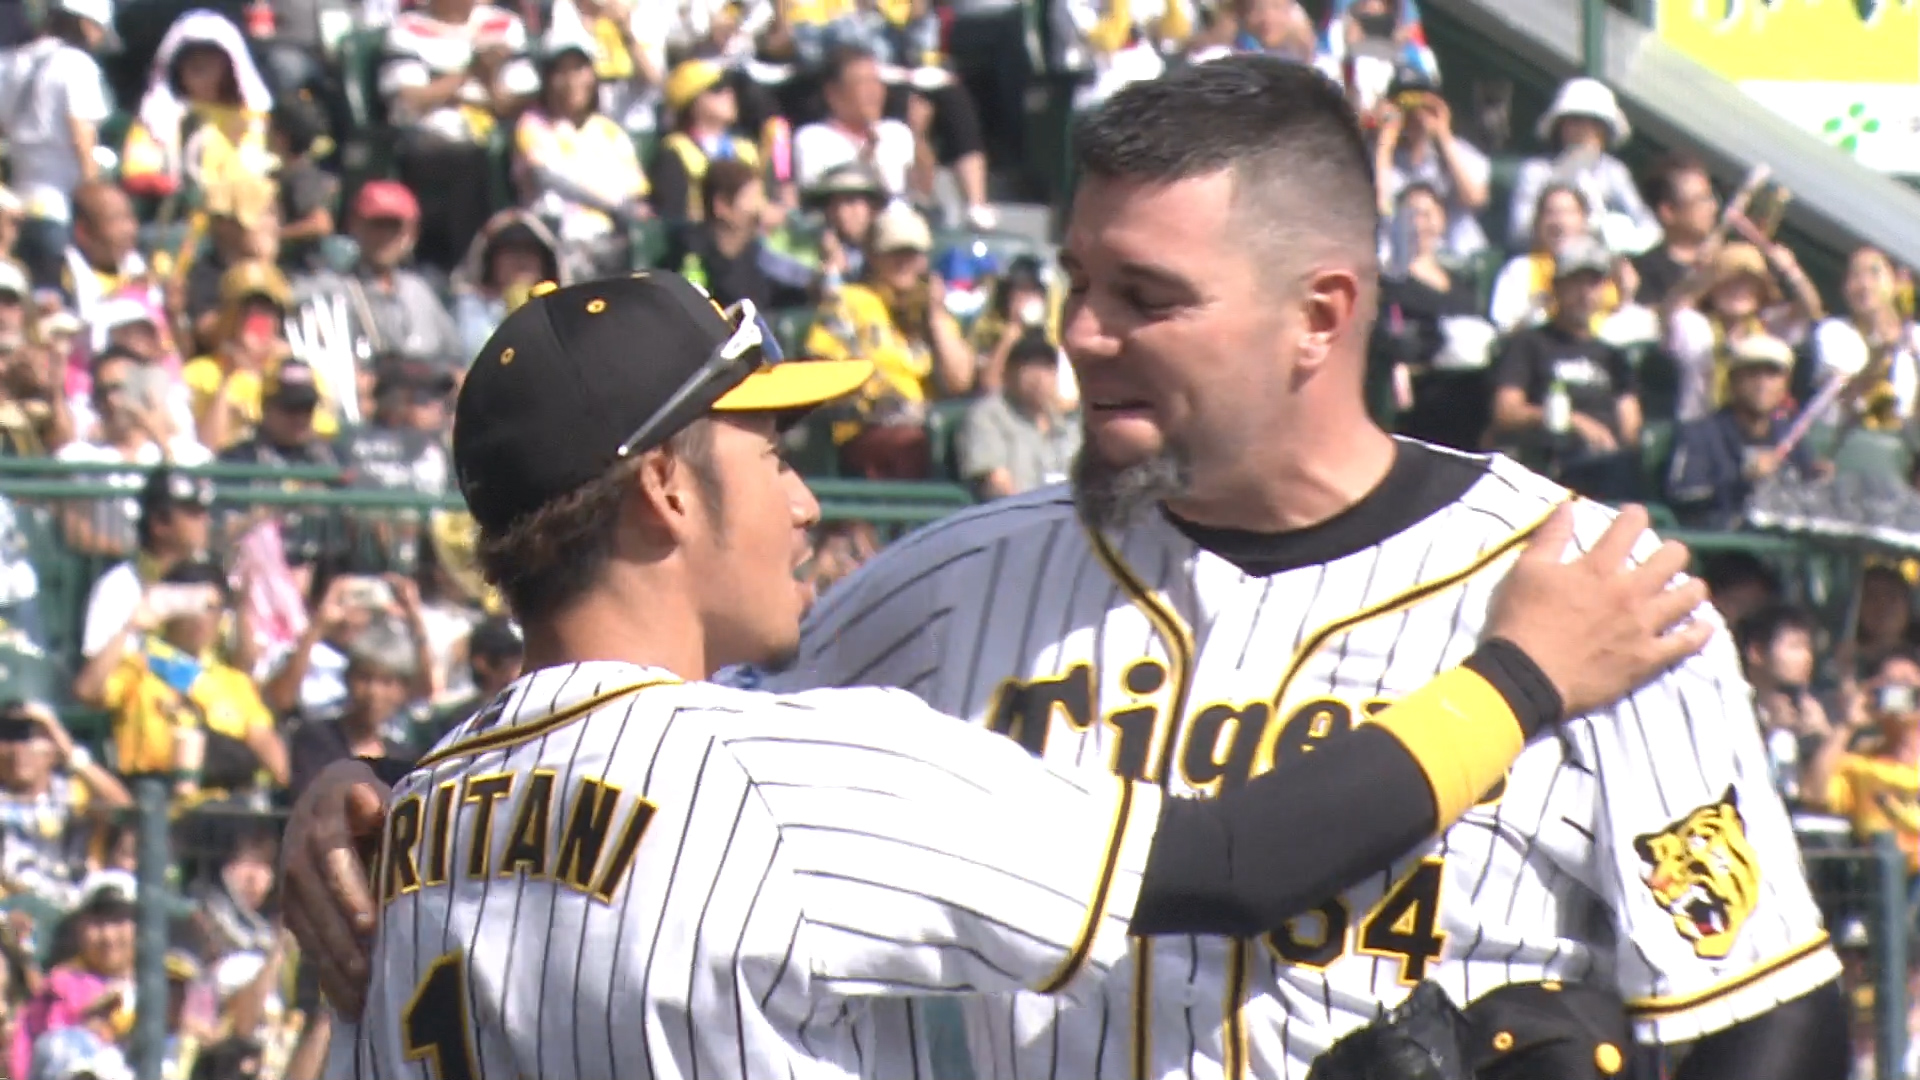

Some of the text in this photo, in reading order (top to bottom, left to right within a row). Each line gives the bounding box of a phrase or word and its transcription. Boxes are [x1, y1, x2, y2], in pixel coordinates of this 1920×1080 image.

[983, 659, 1509, 807] Tige
[369, 769, 657, 904] RITANI
[401, 945, 478, 1080] 1
